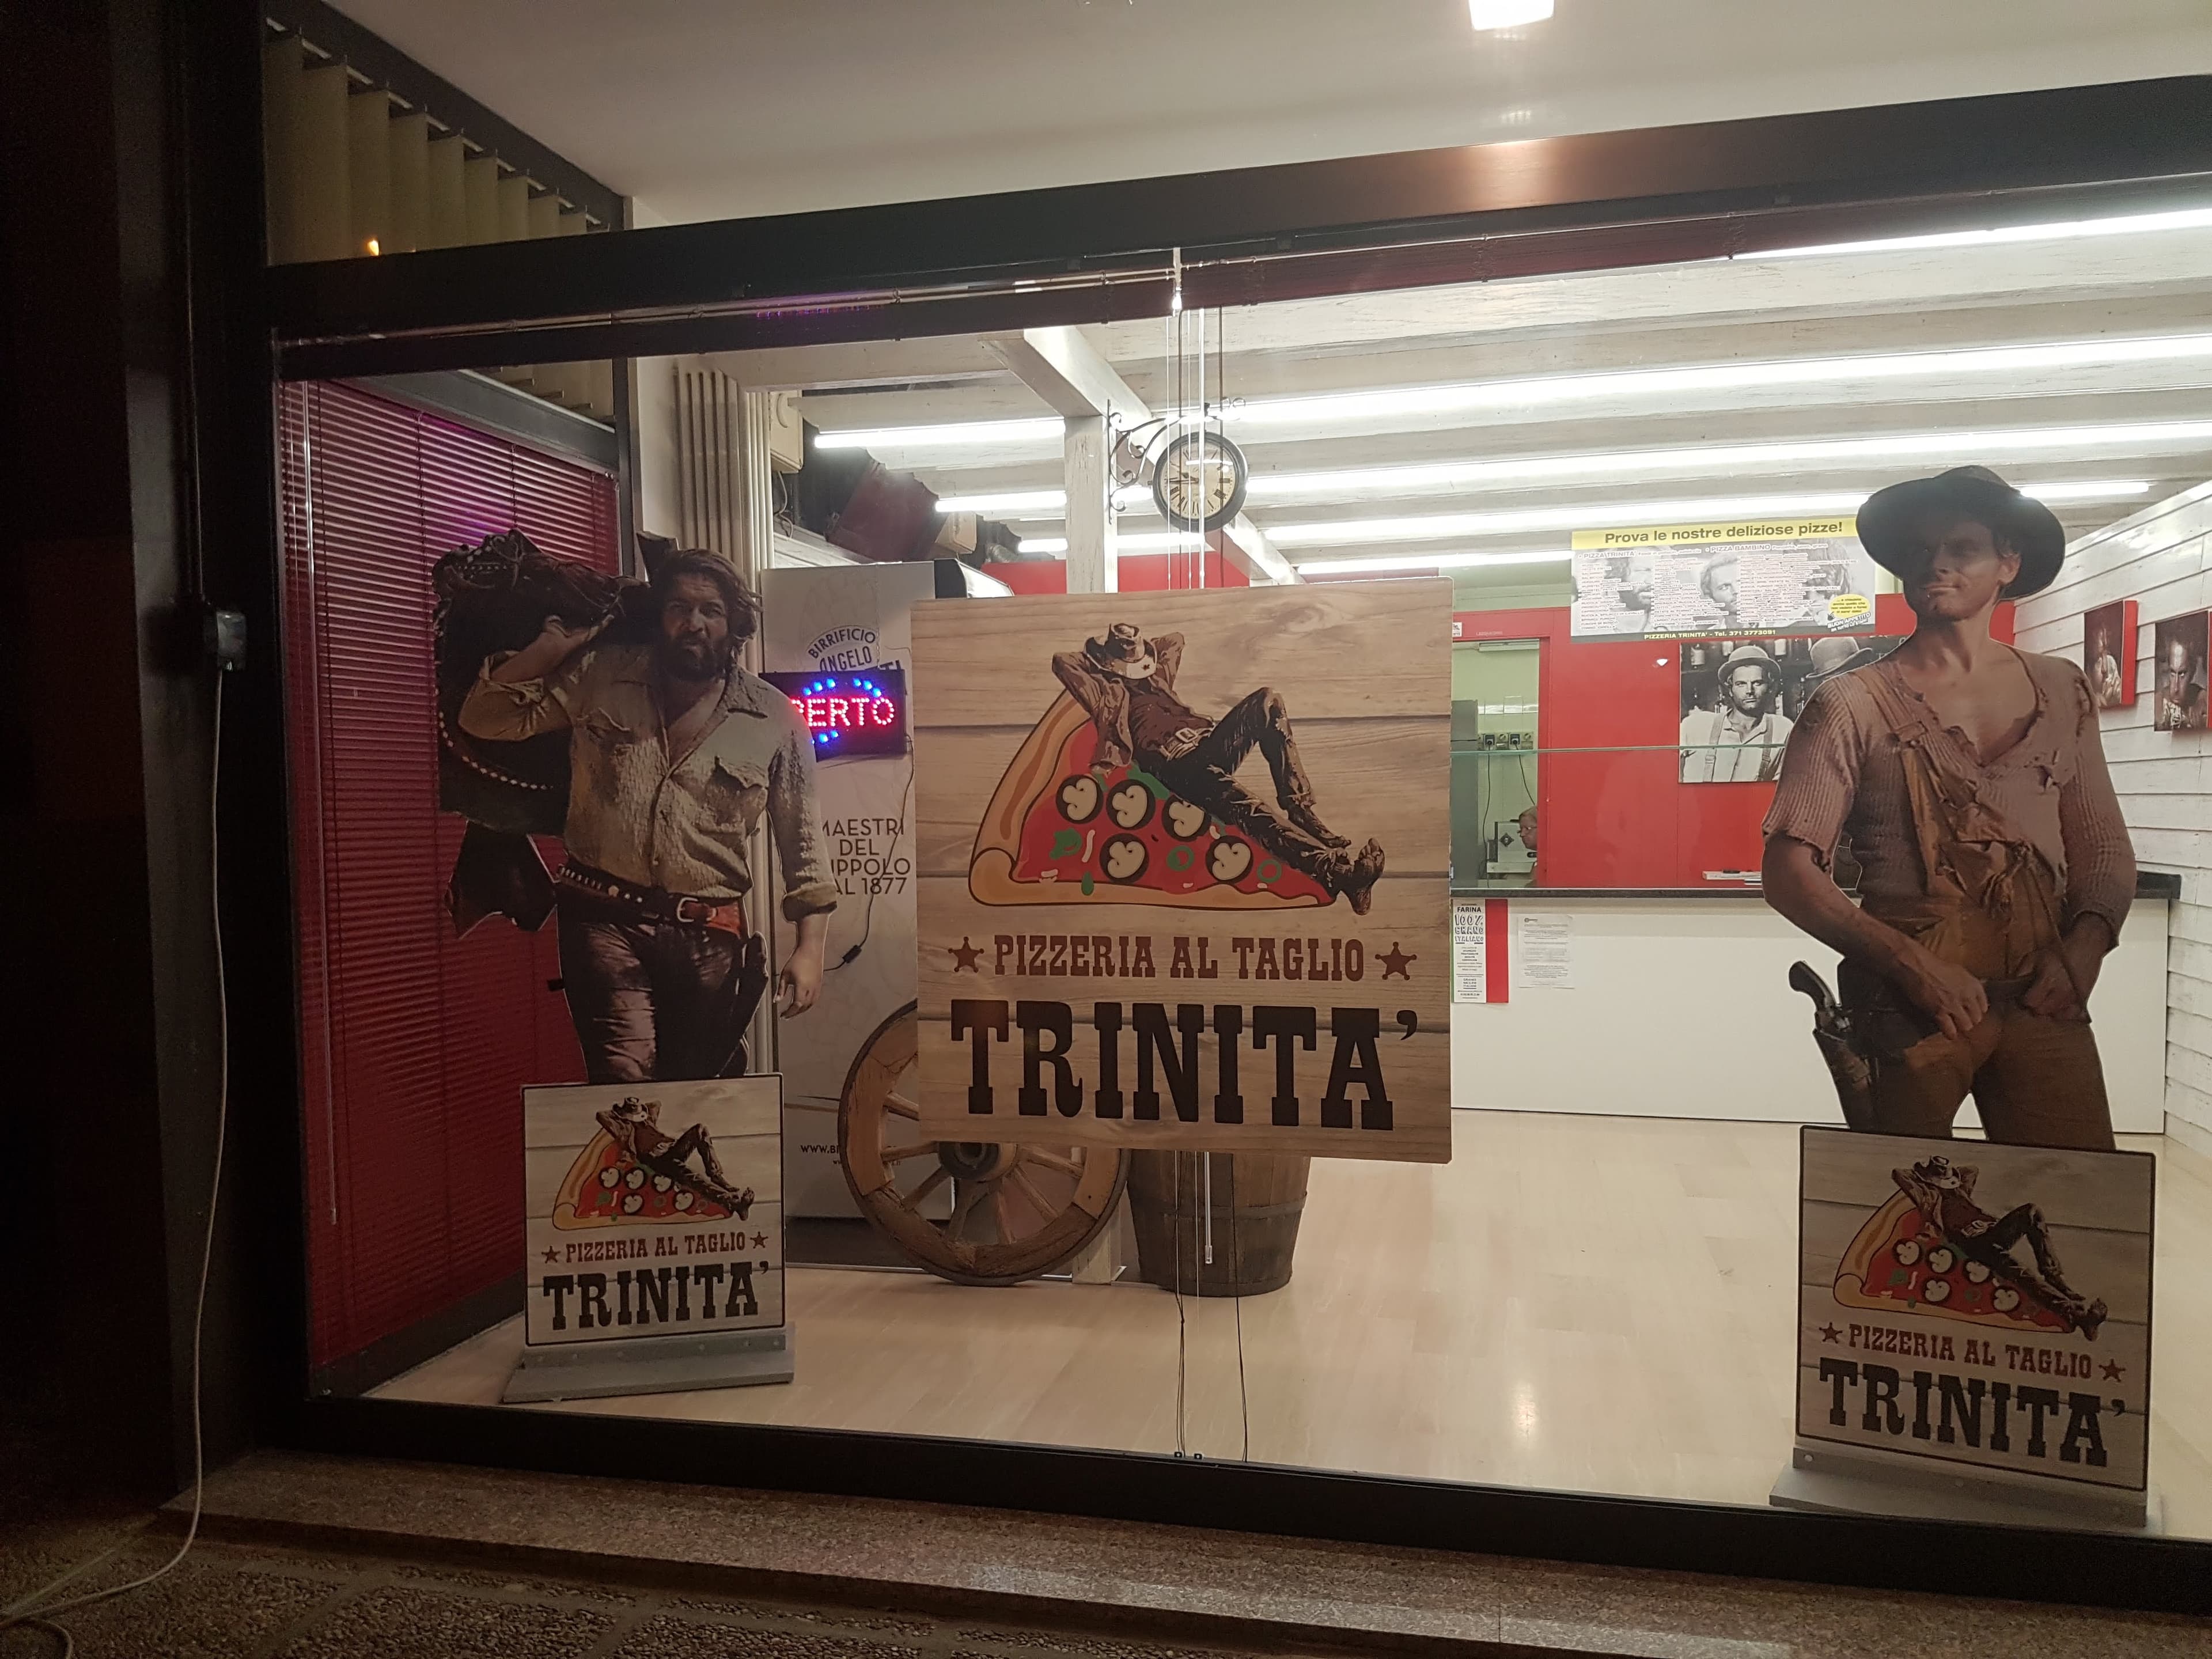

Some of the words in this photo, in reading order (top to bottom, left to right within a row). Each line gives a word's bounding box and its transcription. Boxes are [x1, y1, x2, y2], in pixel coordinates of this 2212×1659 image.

[1605, 533, 1649, 543] Prova
[1654, 531, 1667, 541] le
[1672, 528, 1721, 540] nostre
[1726, 525, 1793, 537] deliziose
[1798, 521, 1842, 536] pizze!
[1827, 620, 1843, 628] BUON
[1844, 613, 1870, 623] APPETITO
[808, 628, 876, 658] BIRRIFICIO
[819, 646, 872, 673] ANGELO
[791, 696, 895, 727] ERTO
[839, 838, 880, 857] DEL
[831, 858, 911, 876] PPOLO
[861, 877, 907, 895] 1877
[1455, 914, 1484, 926] 100%
[1455, 926, 1484, 935] GRANO
[993, 934, 1156, 979] PIZZERIA
[1170, 937, 1219, 979] AL
[1232, 938, 1366, 982] TAGLIO
[950, 999, 1419, 1131] TRINITA'
[566, 1238, 649, 1263] PIZZERIA
[654, 1236, 679, 1256] AL
[684, 1231, 746, 1255] TAGLIO
[543, 1260, 769, 1331] TRINITA'
[1849, 1323, 1956, 1362] PIZZERIA
[1964, 1339, 1996, 1368] AL
[2005, 1344, 2093, 1380] TAGLIO
[1819, 1356, 2126, 1468] TRINITA'
